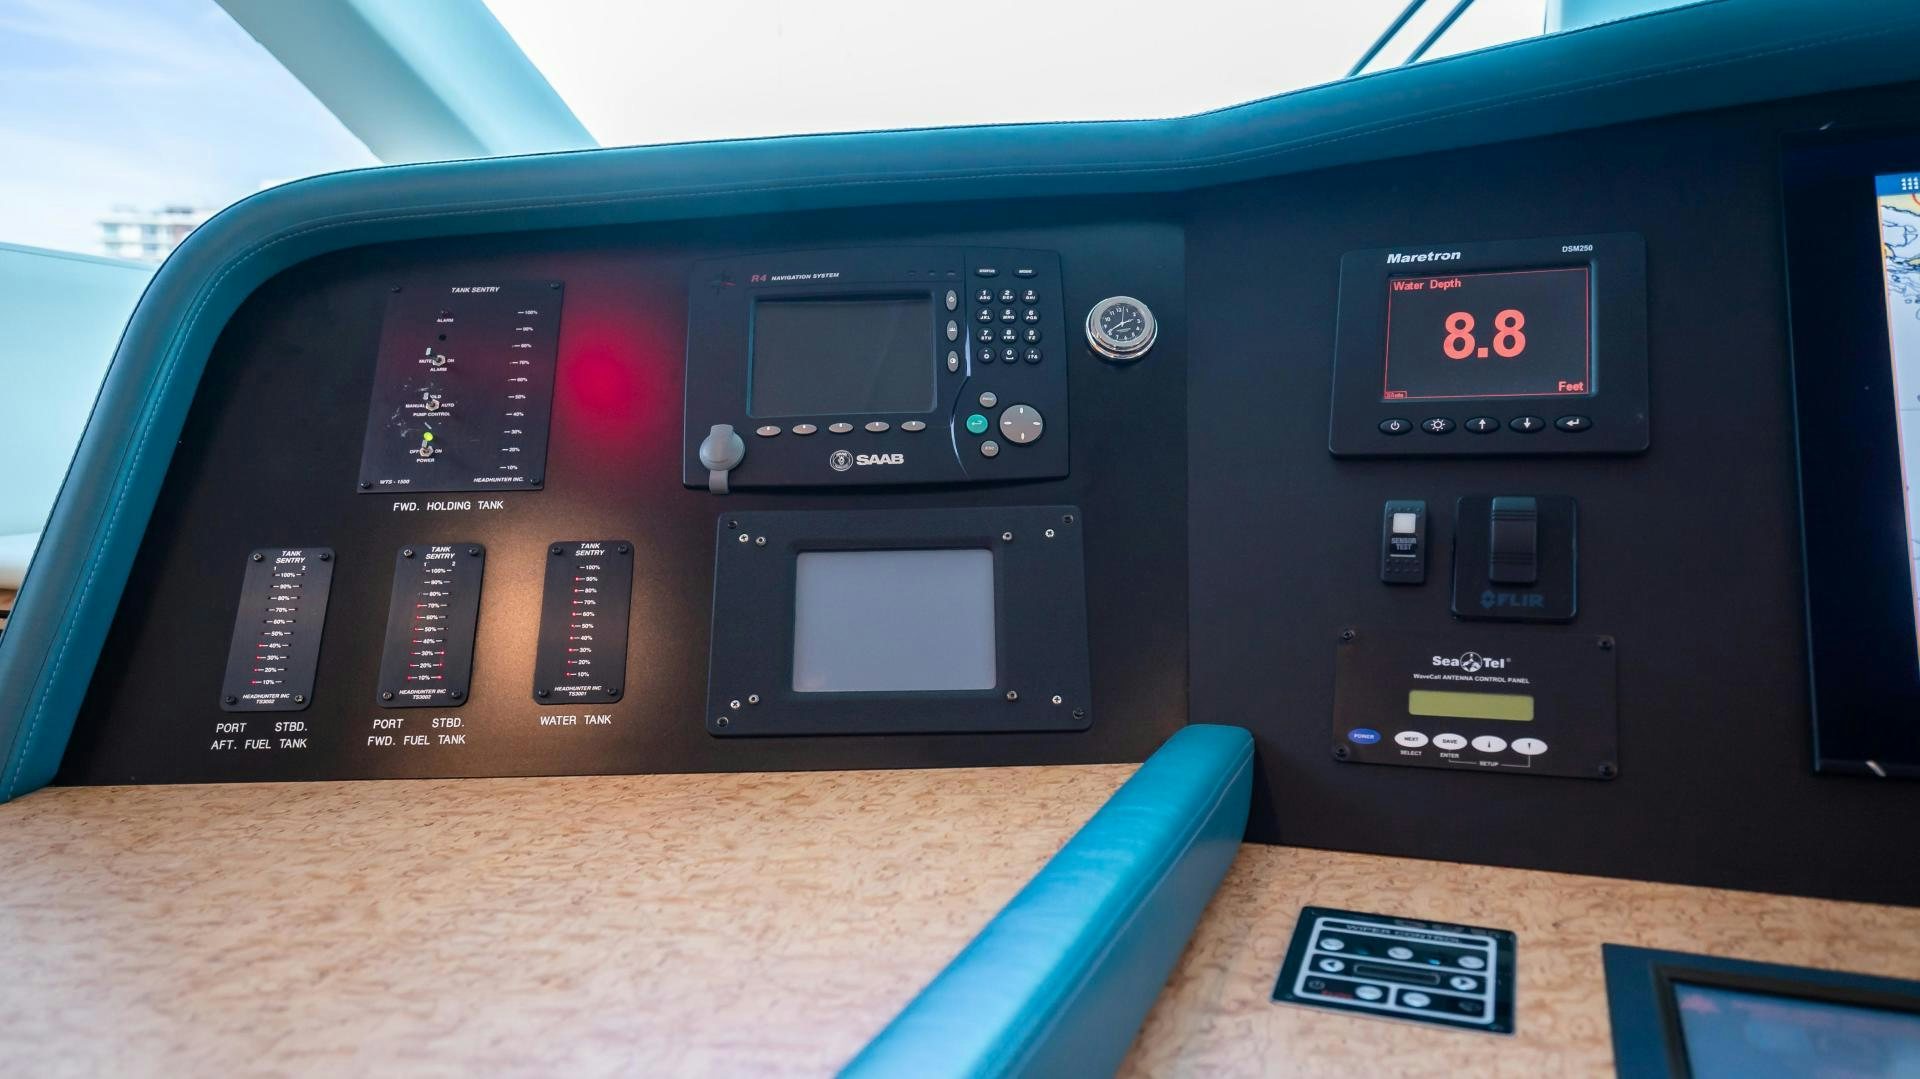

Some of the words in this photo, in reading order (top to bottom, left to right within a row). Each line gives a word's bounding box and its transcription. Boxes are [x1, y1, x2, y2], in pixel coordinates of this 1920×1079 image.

[1562, 245, 1593, 253] DSM250
[1386, 251, 1461, 264] Maretron
[771, 273, 811, 281] NAVIGATION
[1393, 280, 1424, 291] Water
[1430, 278, 1461, 290] Depth
[1443, 309, 1526, 360] 8.8
[1558, 381, 1584, 391] Feet
[856, 453, 905, 466] SAAB
[393, 503, 419, 511] FWD.
[427, 502, 471, 511] HOLDING
[478, 501, 504, 510] TANK
[1497, 593, 1544, 608] FLIR
[1432, 656, 1460, 667] Sea
[1483, 657, 1505, 668] Tel
[373, 719, 404, 729] PORT
[432, 718, 464, 728] STBD.
[540, 716, 577, 725] WATER
[584, 715, 611, 724] TANK
[216, 723, 247, 733] PORT
[275, 722, 308, 732] STBD.
[211, 740, 237, 750] AFT.
[245, 739, 271, 749] FUEL
[279, 738, 308, 749] TANK
[368, 736, 396, 746] FWD.
[404, 735, 430, 745] FUEL
[438, 734, 466, 744] TANK
